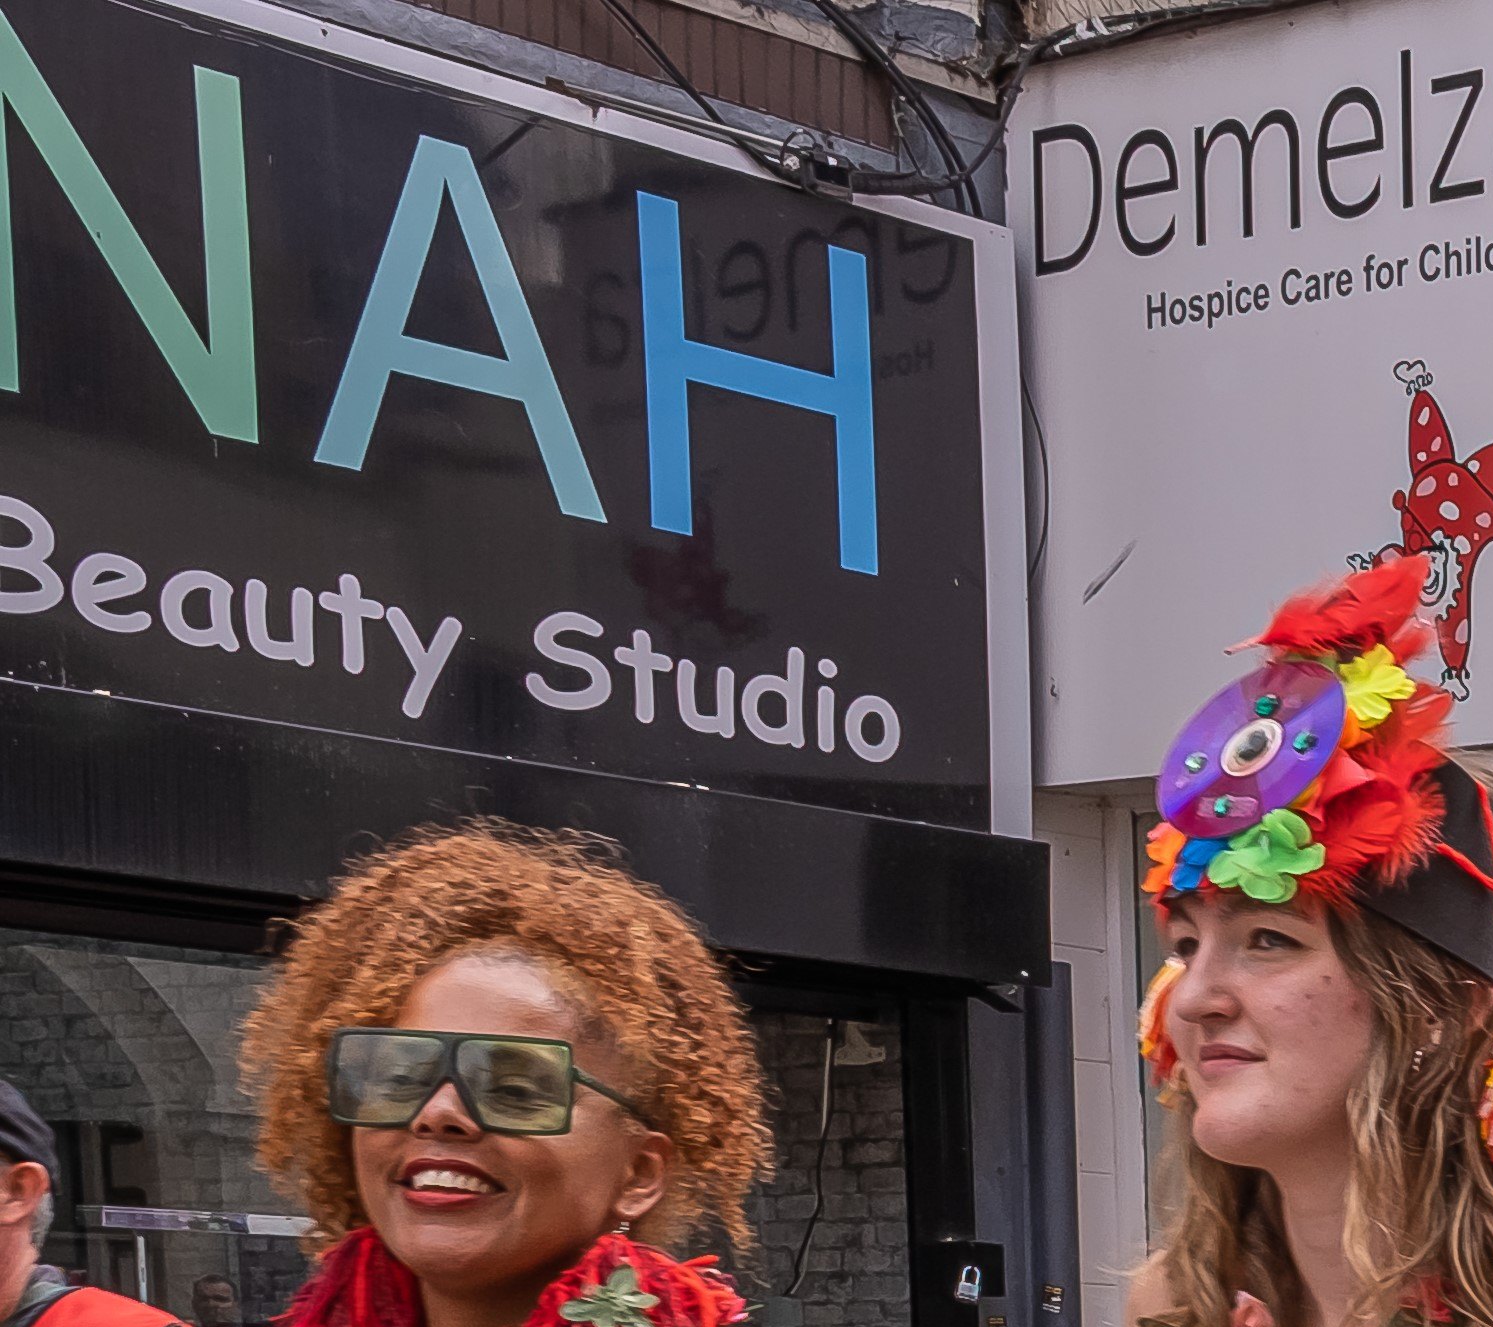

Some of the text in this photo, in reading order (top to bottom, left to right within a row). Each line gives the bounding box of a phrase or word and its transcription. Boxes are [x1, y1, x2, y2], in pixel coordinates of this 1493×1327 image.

[1145, 280, 1270, 329] Hospice
[1280, 266, 1353, 305] Care
[1362, 254, 1409, 292] for
[0, 494, 902, 763] Beauty Studio
